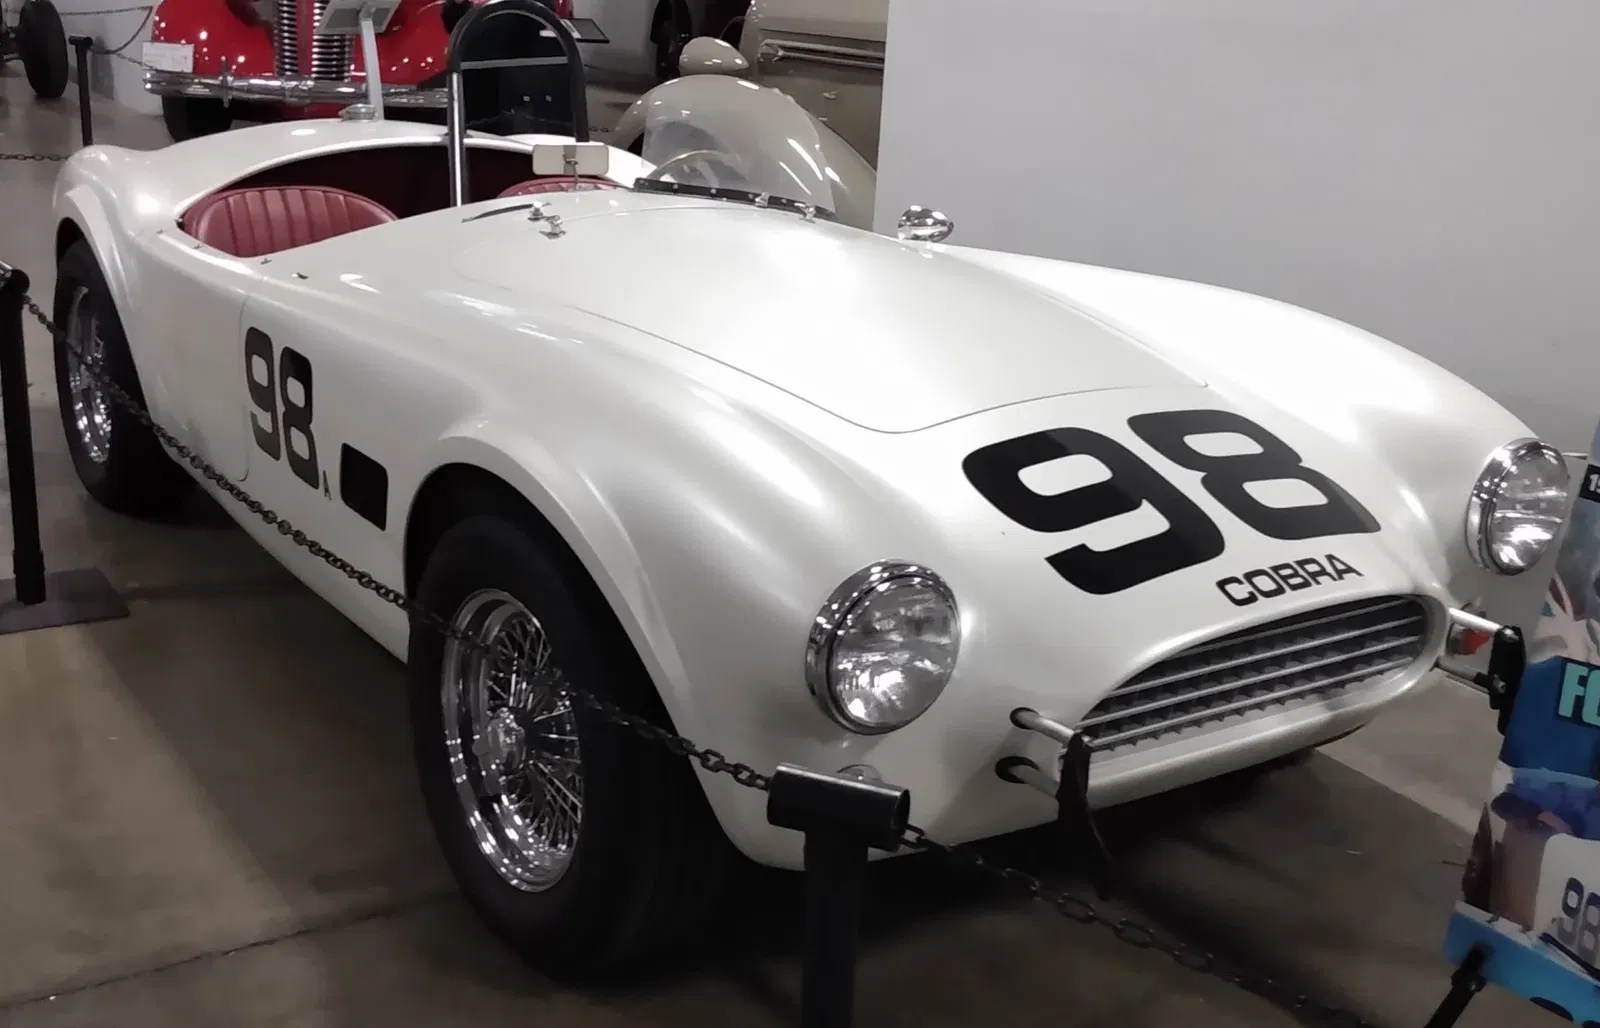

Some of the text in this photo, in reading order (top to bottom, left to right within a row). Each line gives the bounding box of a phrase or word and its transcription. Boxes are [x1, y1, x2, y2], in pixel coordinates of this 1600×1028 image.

[245, 326, 320, 490] 98
[962, 409, 1382, 595] 98
[1215, 553, 1364, 607] COBRA
[1557, 876, 1600, 966] 98
